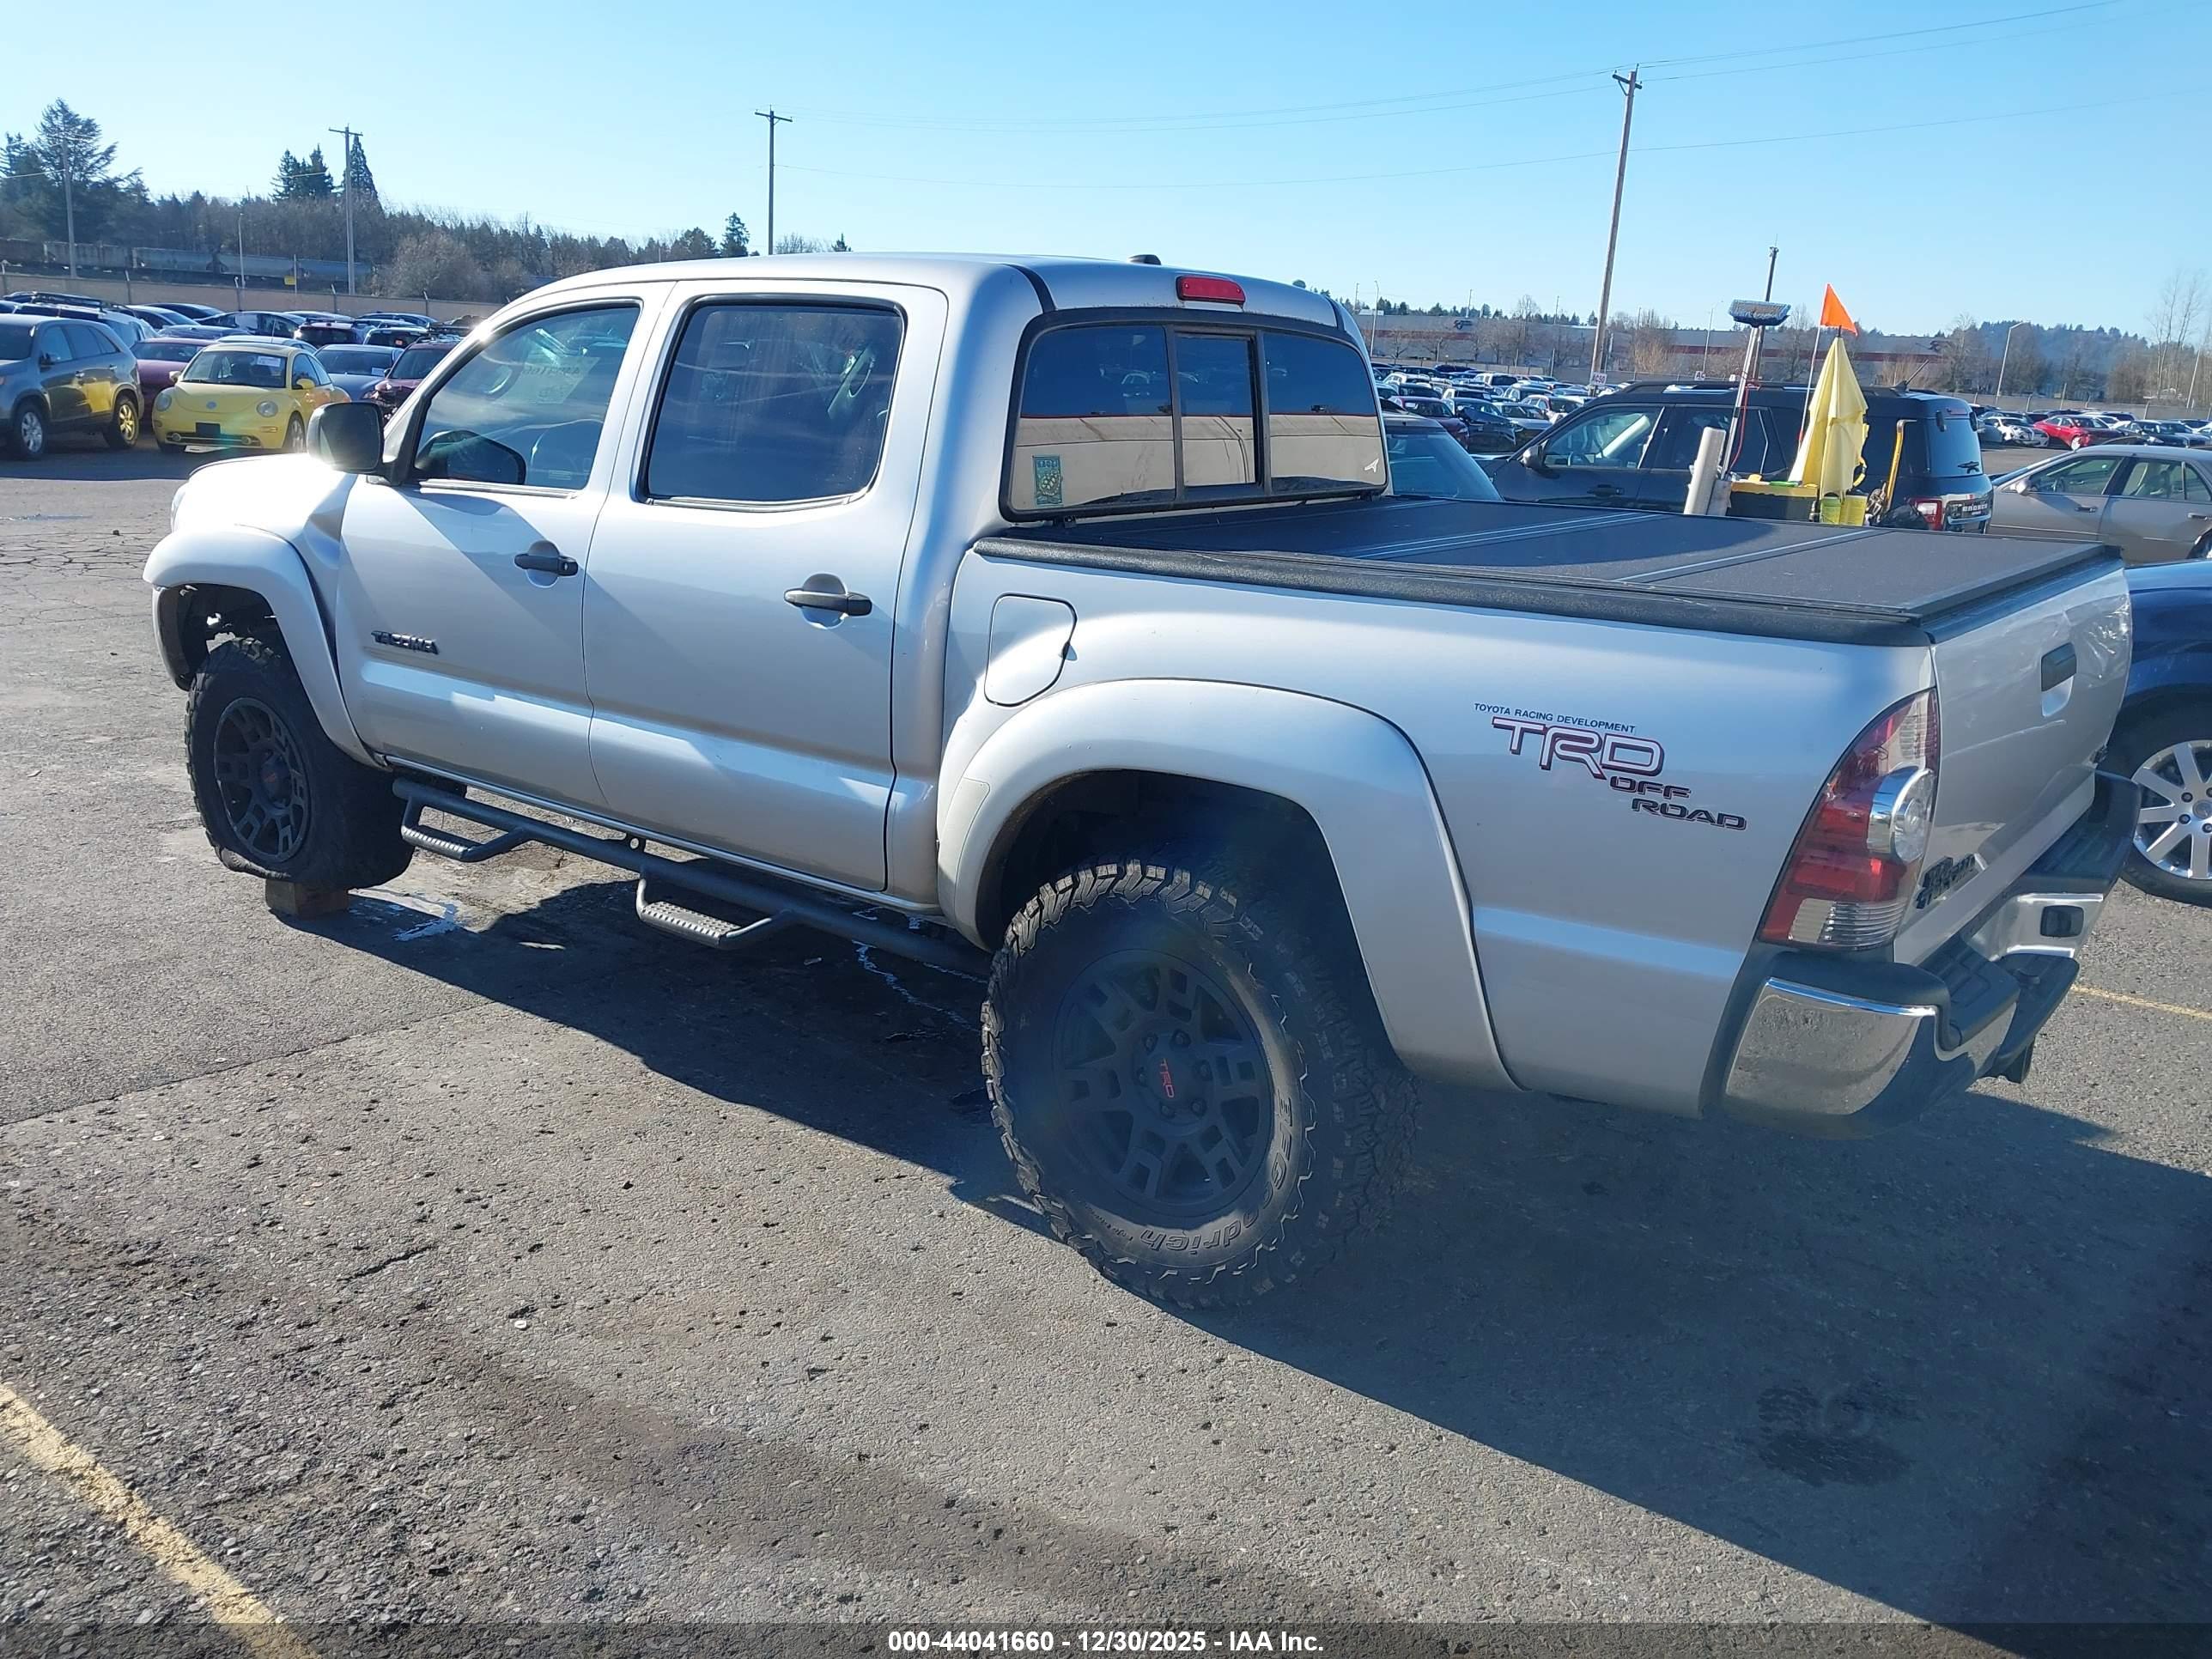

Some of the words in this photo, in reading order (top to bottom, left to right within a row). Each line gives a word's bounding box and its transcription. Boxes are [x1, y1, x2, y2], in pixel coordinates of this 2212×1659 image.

[371, 630, 439, 655] TACOMA
[1474, 702, 1510, 715] TOYOTA
[1514, 708, 1553, 722] RACING
[1557, 714, 1635, 733] DEVELOPMENT
[1492, 716, 1665, 780] TRD
[1610, 775, 1692, 799] OFF
[1632, 798, 1748, 831] ROAD
[1159, 1058, 1175, 1098] TRD
